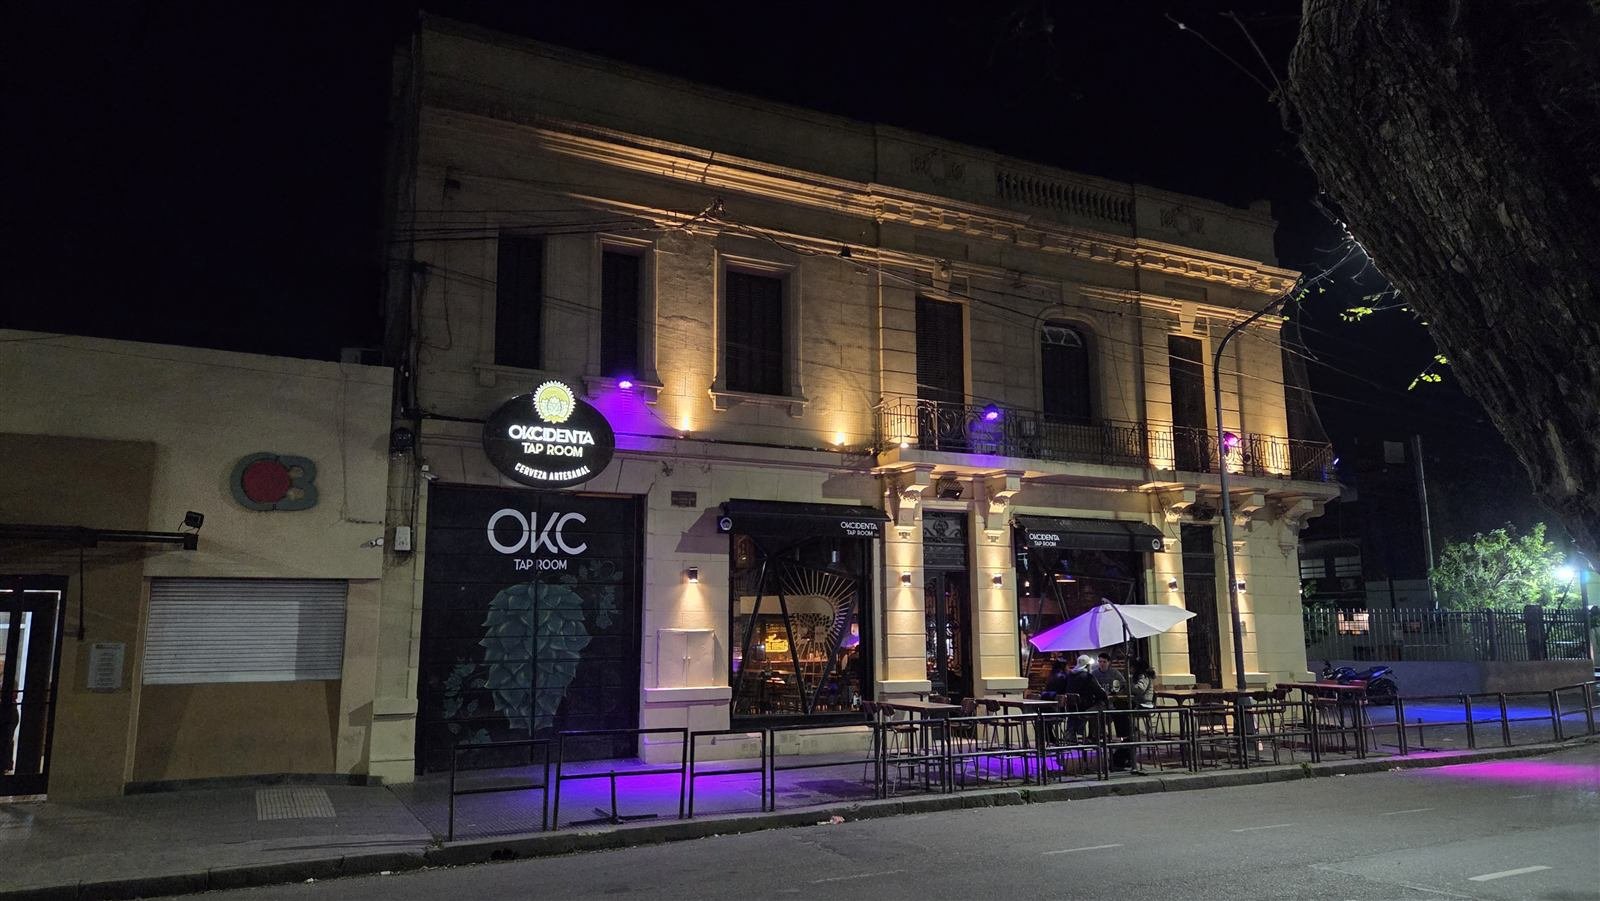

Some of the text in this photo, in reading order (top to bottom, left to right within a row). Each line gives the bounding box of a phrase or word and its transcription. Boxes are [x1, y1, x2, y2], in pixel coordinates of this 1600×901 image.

[508, 424, 595, 445] OKCIDENTA
[521, 442, 583, 457] TAP ROOM
[514, 462, 591, 480] CERVEZA ARTESANAL
[487, 508, 587, 555] OKC
[513, 559, 567, 570] TAP ROOM
